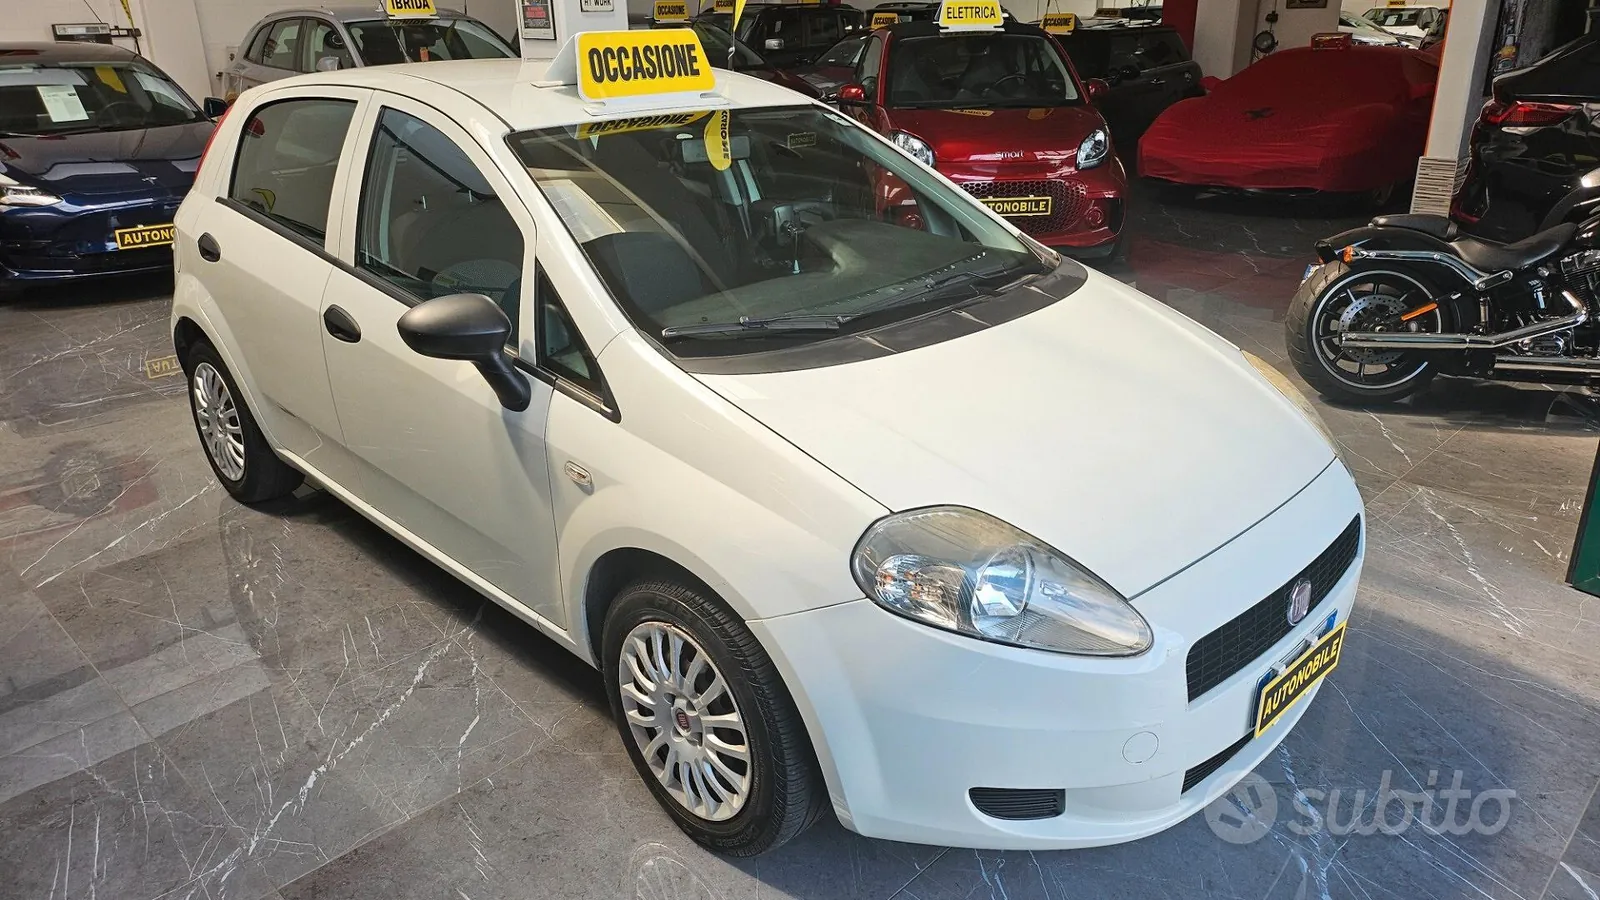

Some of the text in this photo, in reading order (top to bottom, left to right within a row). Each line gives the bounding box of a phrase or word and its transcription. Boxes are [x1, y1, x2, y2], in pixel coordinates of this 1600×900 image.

[391, 0, 430, 9] IBRIDA
[657, 5, 685, 15] OCCASIONE
[946, 6, 996, 19] ELETTRICA
[1043, 17, 1072, 27] OCCASIONE
[588, 44, 700, 83] OCCASIONE
[985, 201, 1047, 213] TONOBILE
[1263, 637, 1340, 720] AUTONOBILE
